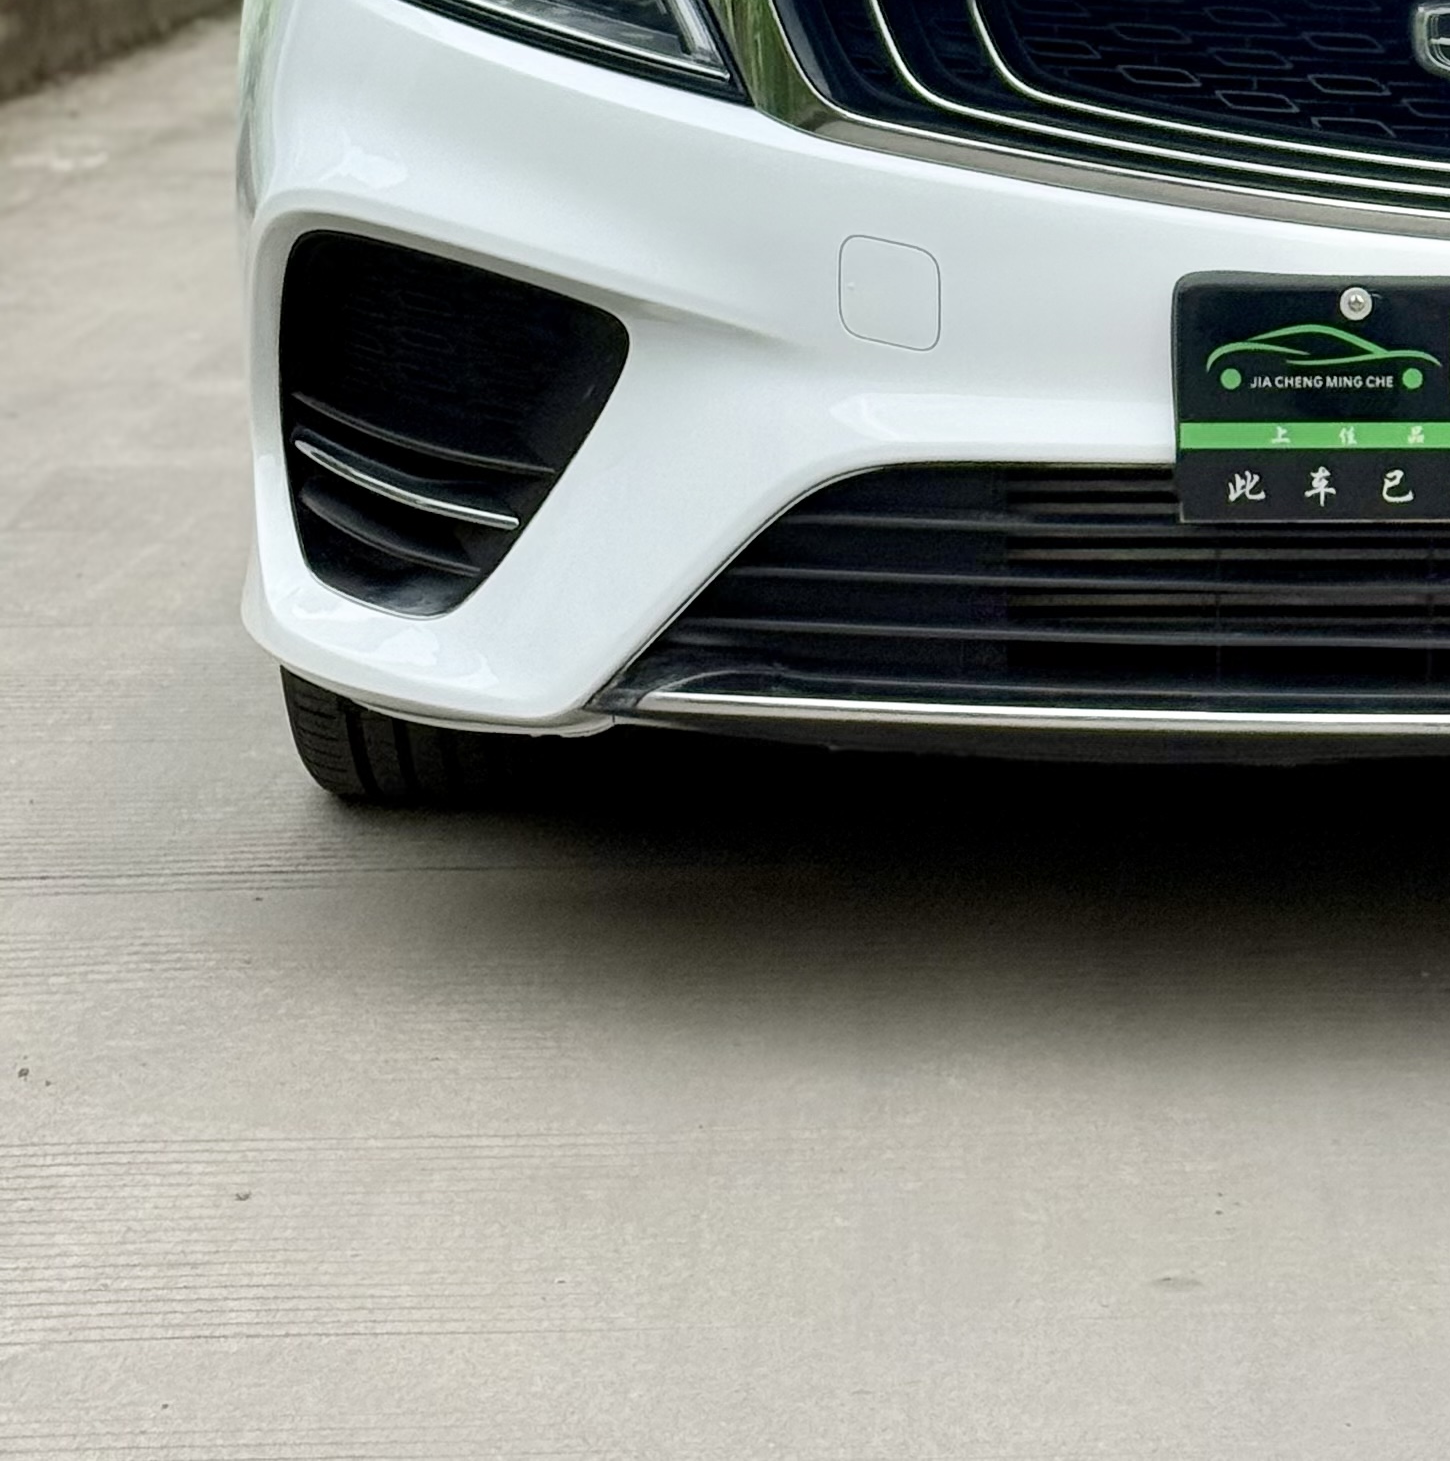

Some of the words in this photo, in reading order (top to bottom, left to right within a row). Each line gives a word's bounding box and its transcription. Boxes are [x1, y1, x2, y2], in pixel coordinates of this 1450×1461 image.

[1250, 376, 1272, 388] JIA
[1274, 375, 1323, 388] CHENG
[1325, 375, 1363, 388] MING
[1365, 375, 1394, 388] CHE
